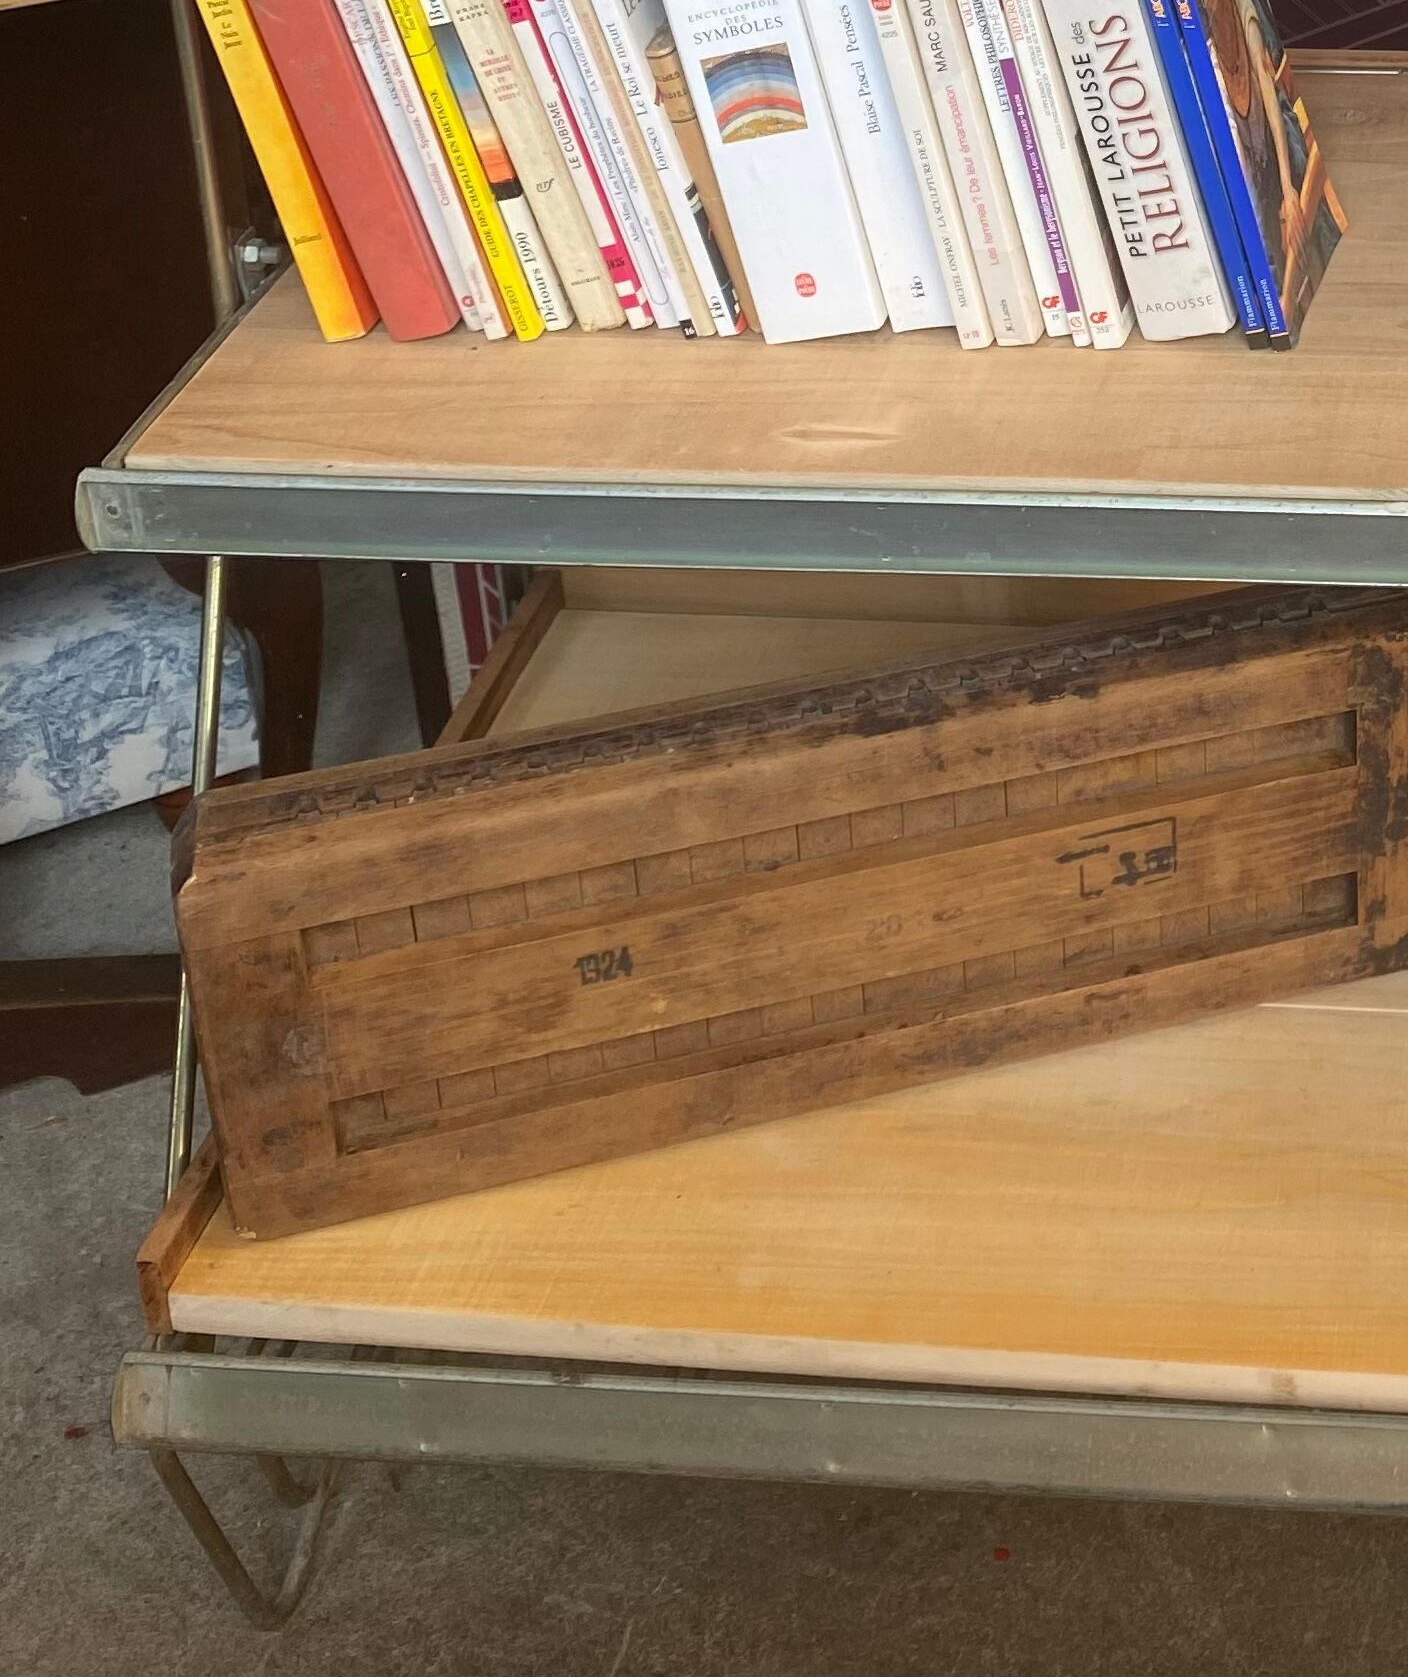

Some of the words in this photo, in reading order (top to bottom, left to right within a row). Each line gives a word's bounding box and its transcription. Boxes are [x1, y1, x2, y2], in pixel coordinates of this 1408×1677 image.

[693, 16, 784, 45] SYMBOLES
[726, 14, 746, 26] DES
[835, 3, 860, 53] Pensées
[1069, 21, 1085, 45] des
[604, 21, 628, 60] meurt
[927, 30, 948, 72] MARC
[619, 60, 633, 75] se
[850, 60, 872, 97] Pascal
[624, 75, 642, 98] Roi
[989, 66, 1011, 112] LETTRES
[427, 88, 456, 139] BRETAGNE
[632, 98, 648, 116] Le
[860, 98, 882, 135] Blaise
[1072, 51, 1125, 181] LAROUSSE
[545, 99, 576, 153] CUBISME
[912, 128, 925, 145] SOI
[1088, 13, 1189, 254] RELIGIONS
[447, 138, 461, 153] EN
[566, 153, 583, 170] LE
[643, 126, 669, 172] Ionesco
[917, 146, 929, 159] DE
[453, 153, 483, 209] CHAPELLES
[920, 160, 943, 214] SCULPTURE
[474, 208, 490, 228] DES
[935, 214, 947, 227] LA
[1112, 189, 1147, 259] PETIT
[482, 226, 502, 258] GUIDE
[512, 229, 537, 265] 1990
[940, 234, 959, 271] ONFRAY
[502, 282, 530, 333] GISSEROT
[525, 264, 560, 324] Détours
[950, 271, 968, 307] MICHEL
[1138, 295, 1214, 314] LAROUSSE
[1233, 274, 1257, 327] Flammarion
[1257, 277, 1281, 330] Flammarion
[684, 328, 696, 336] 16
[574, 946, 634, 986] 1924
